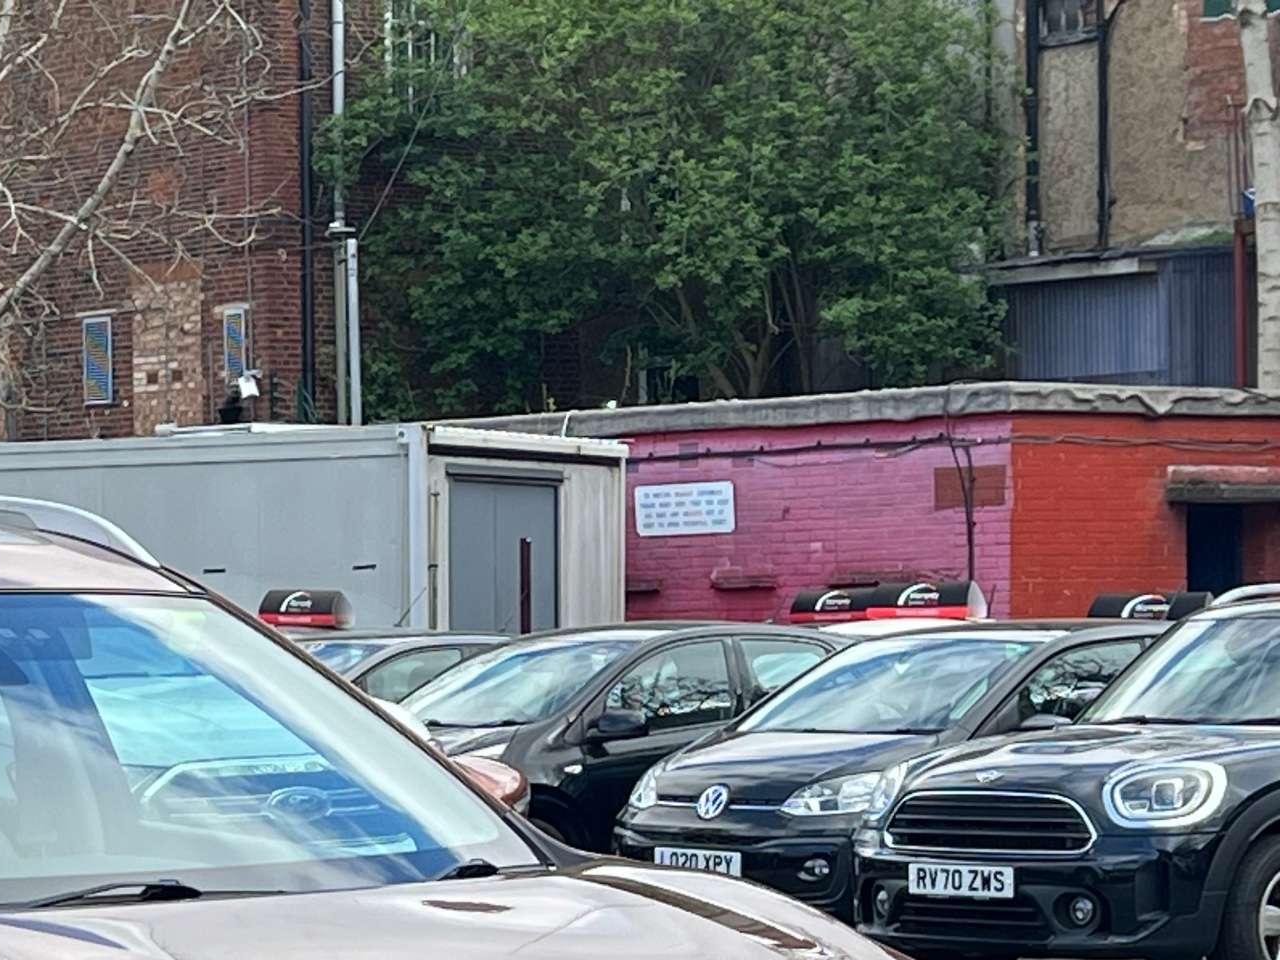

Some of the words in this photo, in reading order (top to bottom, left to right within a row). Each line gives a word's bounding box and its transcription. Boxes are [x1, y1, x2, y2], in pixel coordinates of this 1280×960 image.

[704, 853, 733, 875] XPY
[916, 867, 963, 890] RV70
[967, 869, 1005, 892] ZWS
